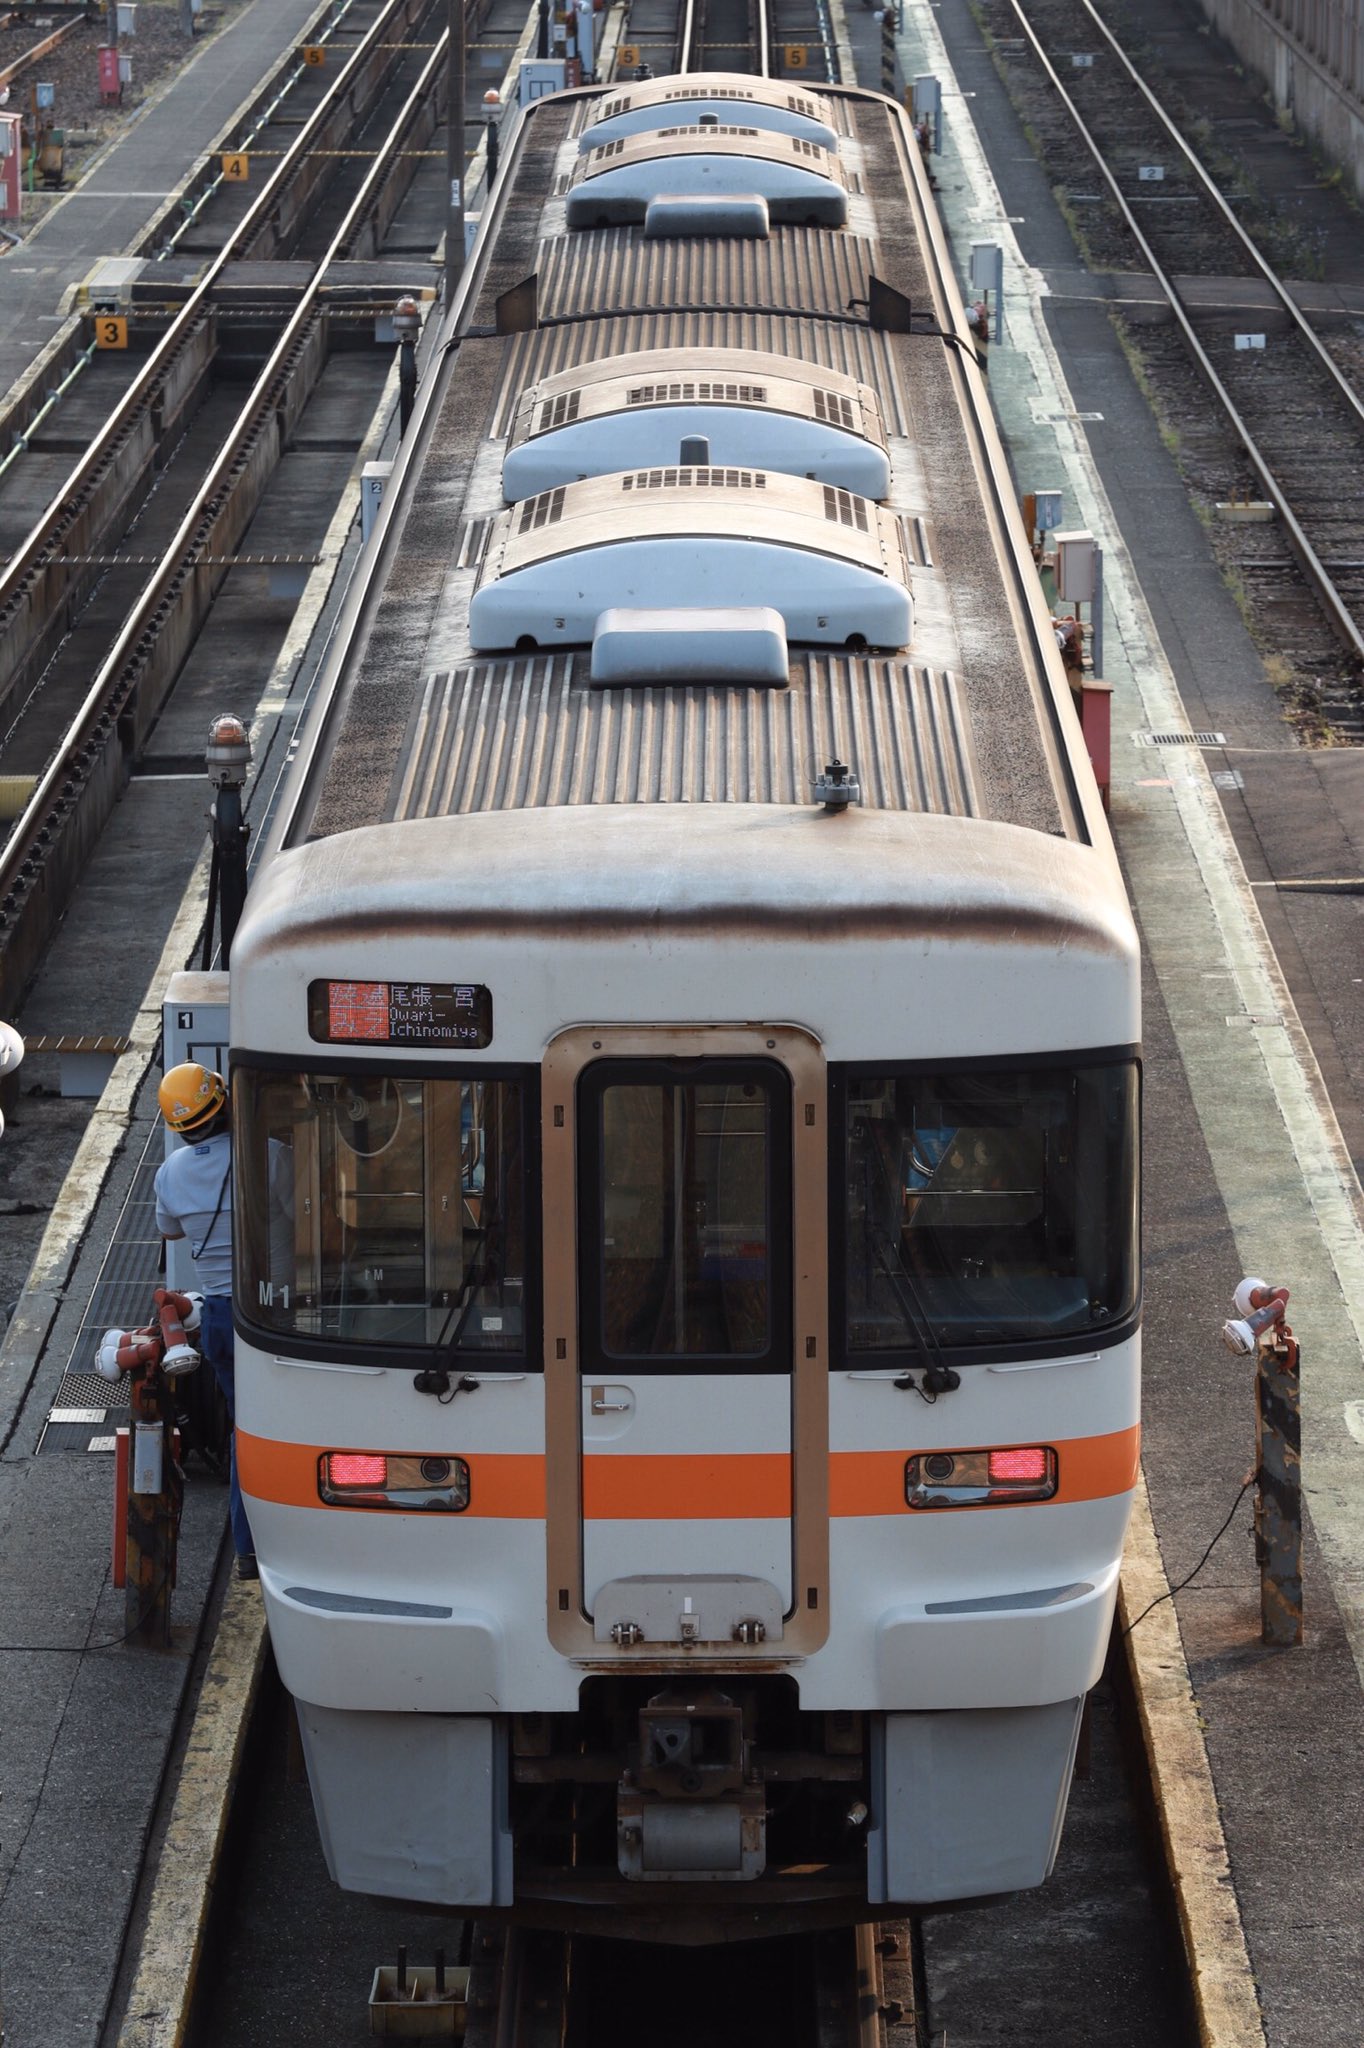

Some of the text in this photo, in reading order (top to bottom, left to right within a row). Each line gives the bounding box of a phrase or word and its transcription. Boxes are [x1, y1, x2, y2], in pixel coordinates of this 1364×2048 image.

[310, 51, 319, 63] 5
[624, 51, 633, 63] 5
[792, 51, 801, 64] 5
[230, 160, 241, 176] 4
[1147, 169, 1156, 178] 2
[104, 323, 118, 343] 3
[373, 483, 381, 493] 2
[389, 985, 475, 1007] 尾張一宮
[181, 1013, 190, 1028] 1
[389, 1007, 446, 1022] Owari-
[390, 1022, 478, 1038] Ichinomiya
